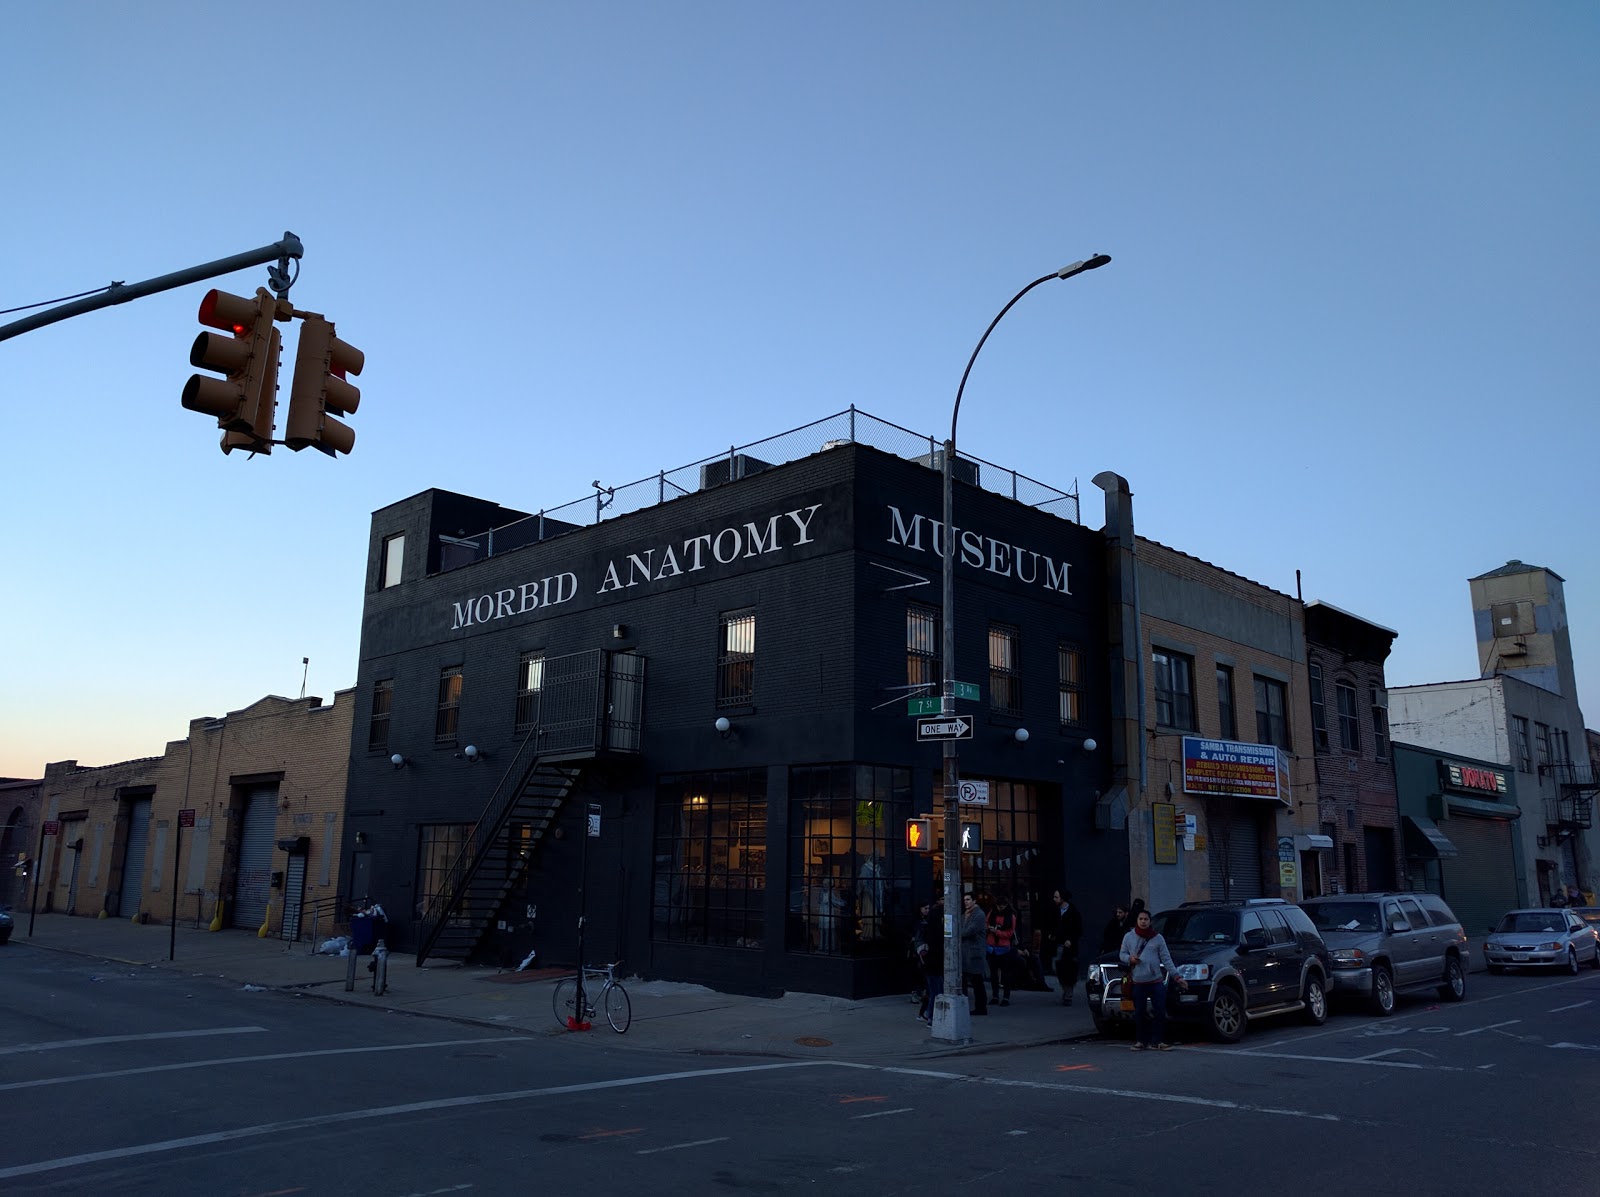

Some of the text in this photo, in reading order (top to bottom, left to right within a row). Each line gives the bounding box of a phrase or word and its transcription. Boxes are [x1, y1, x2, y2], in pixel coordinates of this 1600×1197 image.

[886, 505, 1072, 595] MUSEUM
[450, 503, 822, 630] MORBID ANATOMY
[960, 684, 965, 696] 3
[918, 700, 933, 713] 7 St
[925, 723, 964, 734] ONE WAY
[1200, 742, 1274, 757] SAMBA TRANSMISSION
[1200, 751, 1275, 765] & AUTO REPAIR
[1186, 768, 1215, 777] COMPLETE
[1248, 773, 1275, 782] DOMESTIC
